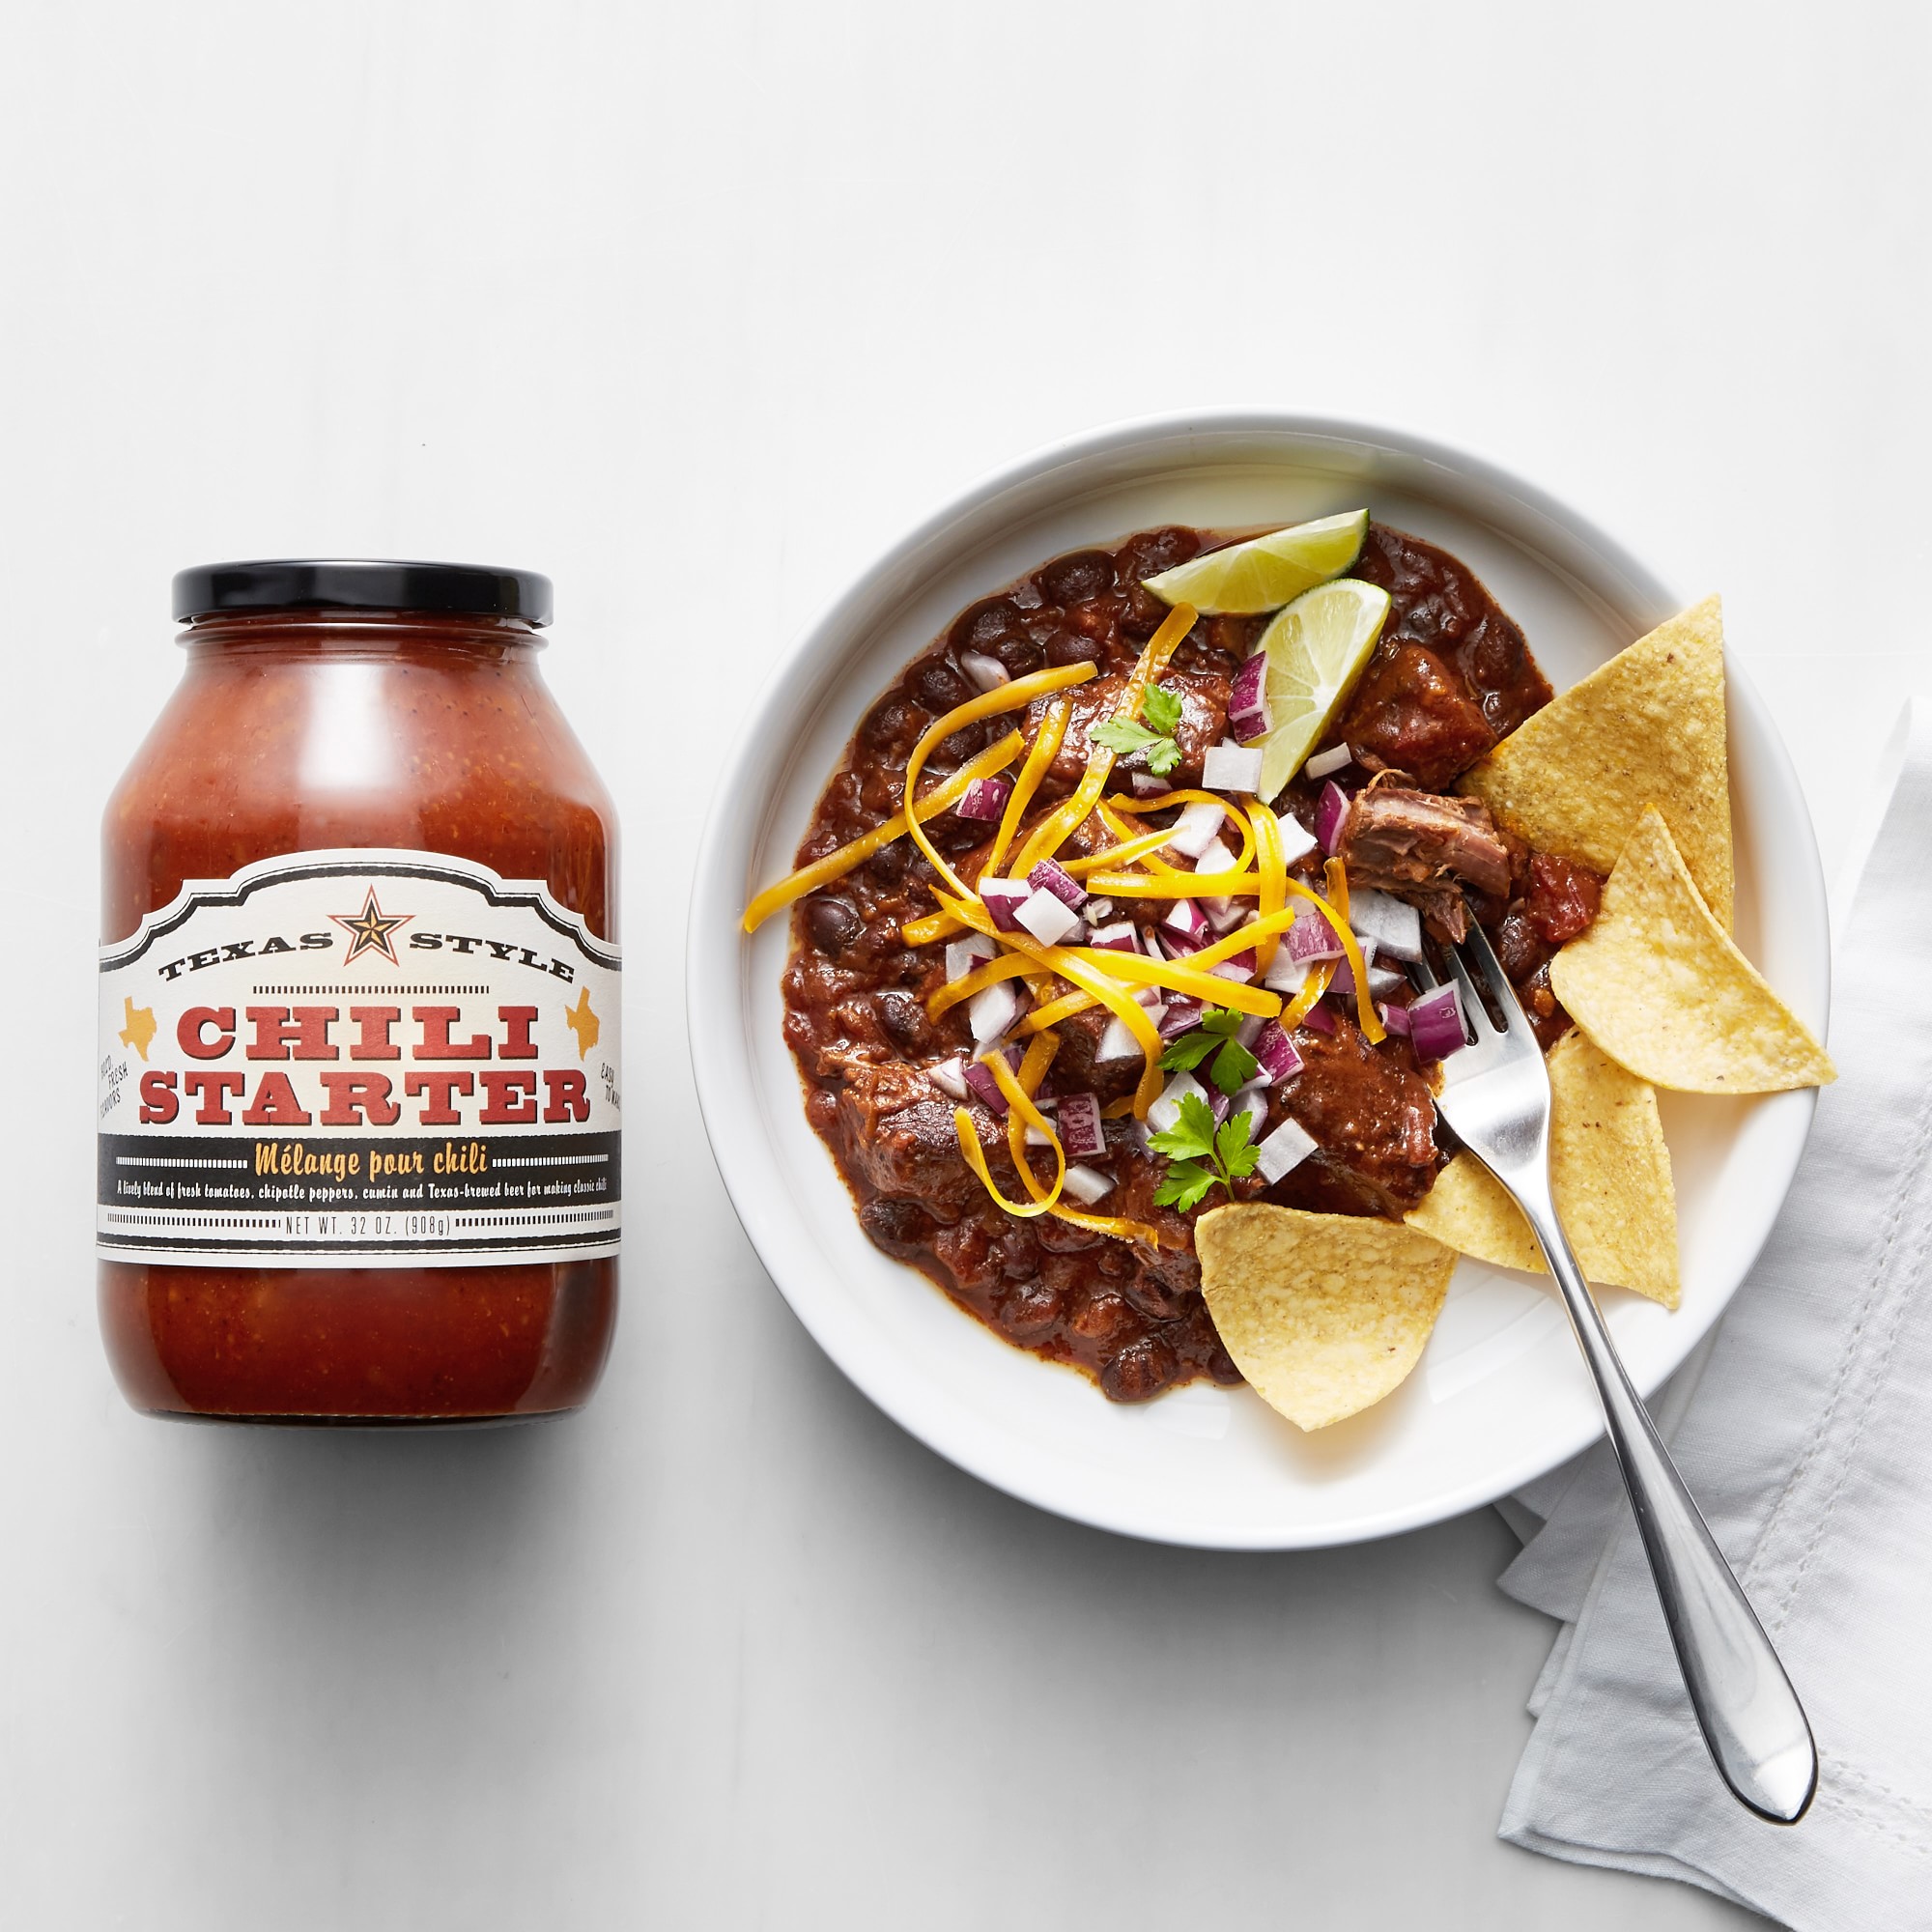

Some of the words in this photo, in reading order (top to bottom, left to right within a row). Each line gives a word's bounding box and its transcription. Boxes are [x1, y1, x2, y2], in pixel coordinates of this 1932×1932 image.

[158, 932, 333, 981] TEXAS
[410, 932, 575, 984] STYLE
[176, 1006, 539, 1061] CHILI
[107, 1061, 128, 1090] FRESH
[138, 1068, 591, 1125] STARTER
[255, 1142, 361, 1182] Mélange
[369, 1150, 425, 1182] pour
[433, 1142, 488, 1176] chili
[117, 1180, 123, 1195] A
[123, 1180, 142, 1199] lively
[143, 1181, 164, 1197] blend
[165, 1182, 176, 1200] of
[177, 1181, 202, 1200] fresh
[204, 1184, 255, 1200] tomatoes,
[258, 1183, 305, 1202] chipotle
[309, 1187, 358, 1203] peppers,
[362, 1185, 398, 1200] cumin
[402, 1183, 424, 1199] and
[428, 1182, 501, 1199] Texas-brewed
[503, 1181, 524, 1197] beer
[526, 1180, 541, 1198] for
[543, 1179, 572, 1197] making
[573, 1179, 594, 1194] classic
[595, 1177, 608, 1191] chili
[286, 1216, 310, 1235] NET
[318, 1216, 342, 1235] WT.
[351, 1216, 366, 1235] 32
[375, 1216, 397, 1235] OZ.
[405, 1215, 451, 1236] (908g)
